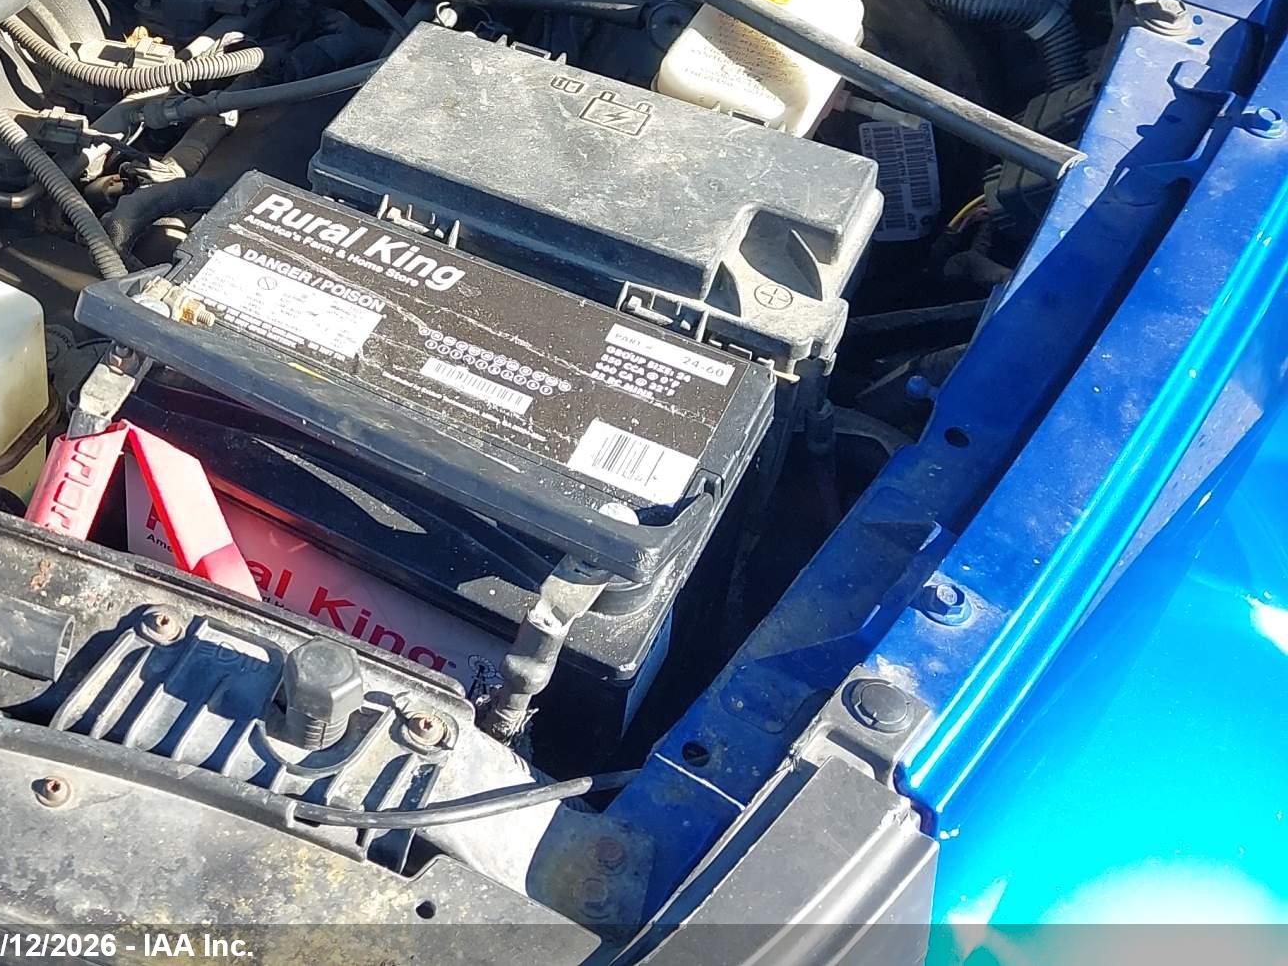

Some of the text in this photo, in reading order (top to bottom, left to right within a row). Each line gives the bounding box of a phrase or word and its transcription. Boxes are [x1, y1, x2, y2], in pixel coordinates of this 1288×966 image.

[243, 214, 419, 287] America's Farm & Home Store
[253, 193, 466, 291] Rural King
[606, 345, 647, 365] GROUP
[675, 371, 692, 383] 24
[622, 362, 645, 376] CCA
[682, 355, 725, 378] 24-60
